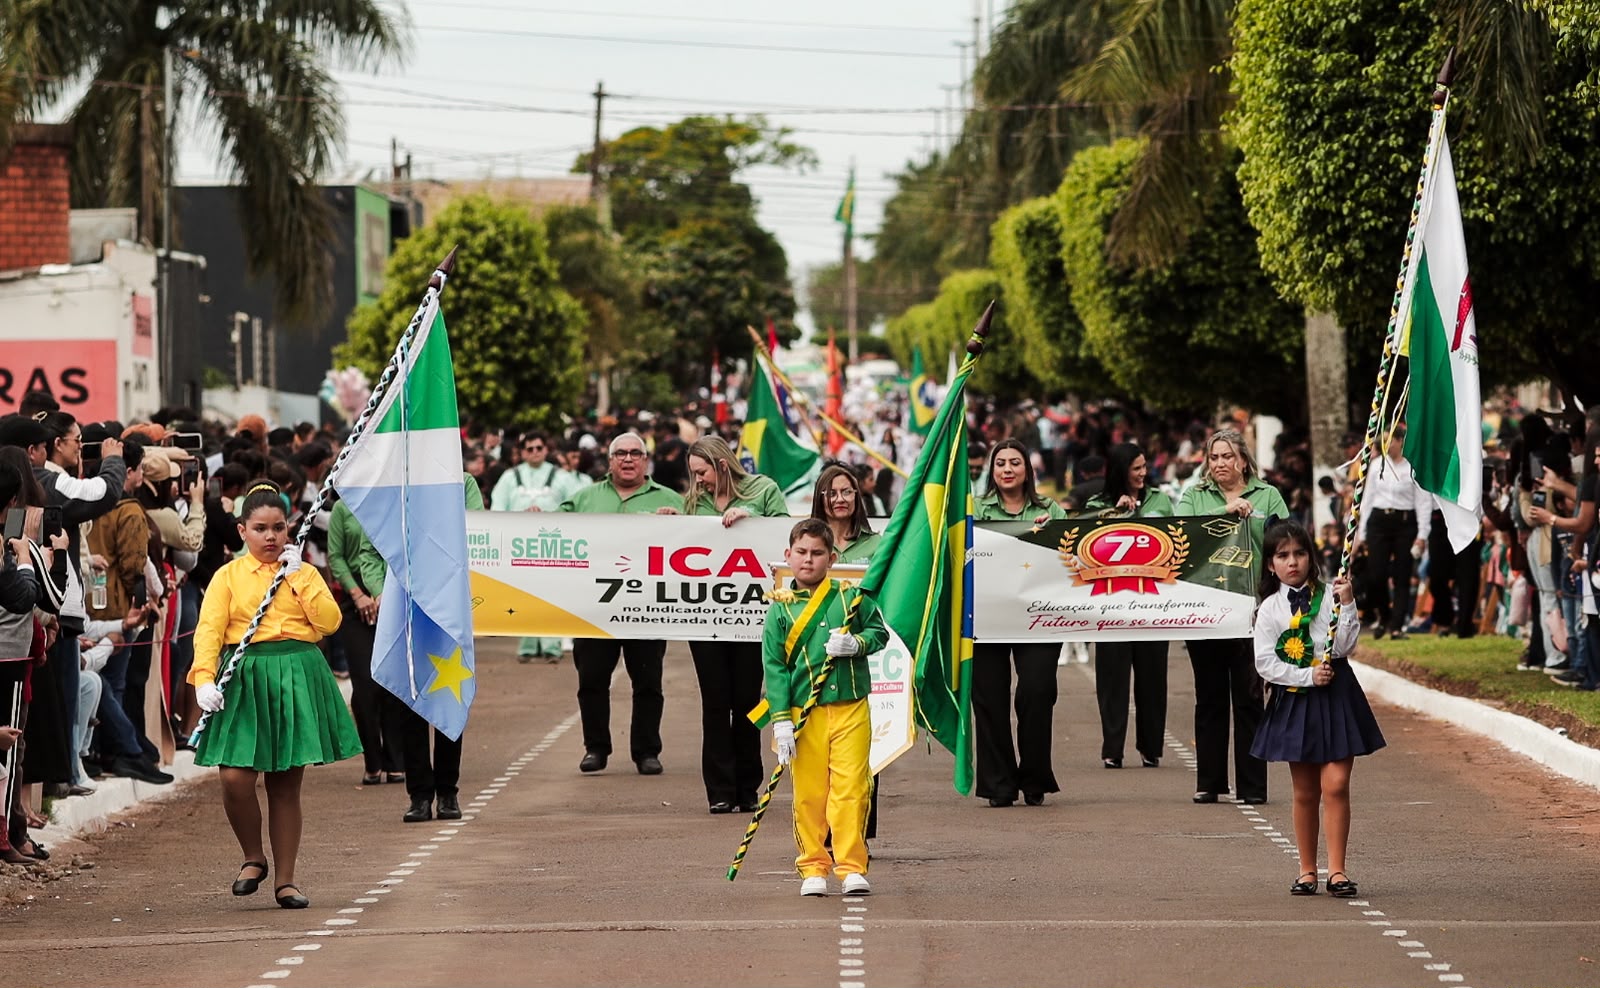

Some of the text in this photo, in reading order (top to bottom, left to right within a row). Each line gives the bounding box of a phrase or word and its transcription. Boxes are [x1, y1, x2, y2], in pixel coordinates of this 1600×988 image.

[467, 532, 490, 545] nel
[511, 537, 589, 559] SEMEC
[468, 546, 499, 559] caia
[1105, 535, 1150, 562] 7º
[648, 546, 767, 578] ICA
[595, 578, 770, 605] 7º LUGA
[646, 605, 718, 614] Indicador
[1027, 599, 1211, 614] Educação que transforma.
[609, 615, 707, 625] Alfabetizada
[713, 617, 751, 626] (ICA)
[1028, 612, 1227, 631] Futuro que se constrói!
[869, 648, 903, 681] EC
